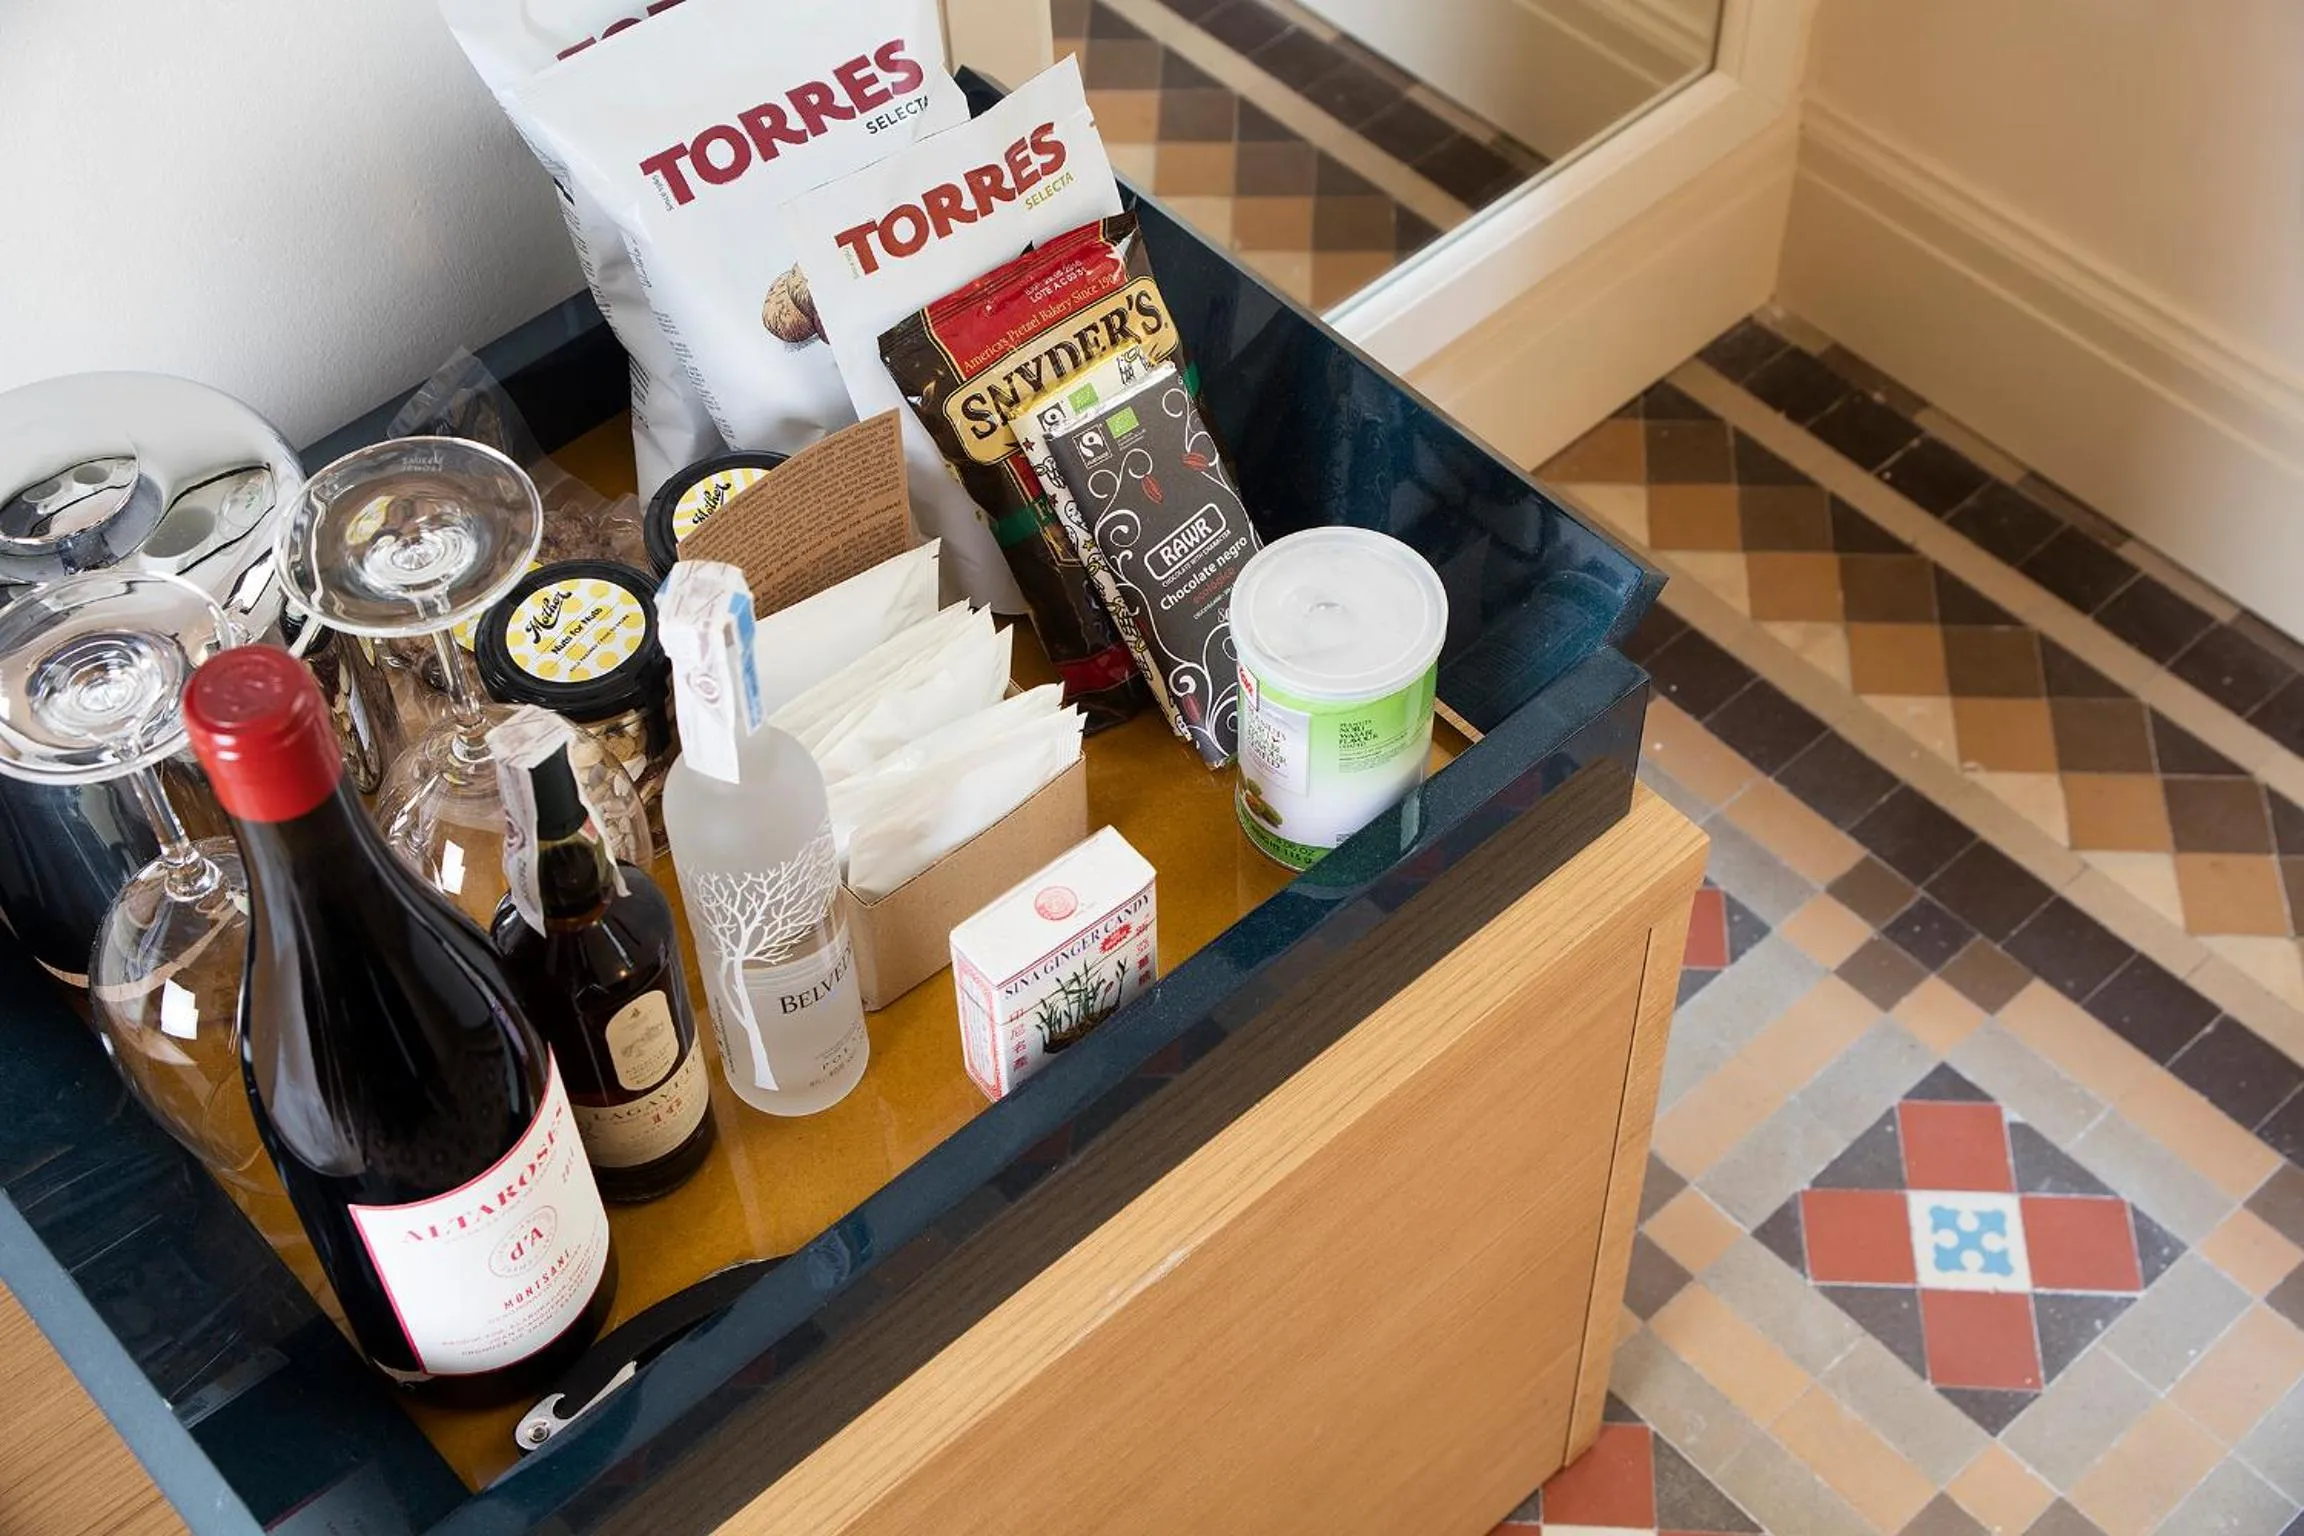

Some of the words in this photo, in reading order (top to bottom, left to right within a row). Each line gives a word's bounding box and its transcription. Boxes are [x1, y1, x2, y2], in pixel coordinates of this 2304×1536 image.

[639, 38, 923, 206] TORRES
[834, 122, 1067, 276] TORRES
[1025, 172, 1074, 210] SELECTA
[964, 335, 1012, 373] America's
[1007, 315, 1039, 345] Pretzel
[1040, 299, 1073, 324] Bakery
[1072, 284, 1099, 304] Since
[961, 290, 1164, 440] SNYDER'S
[1160, 517, 1213, 567] RAWR
[1160, 562, 1217, 611] Chocolate
[1216, 536, 1248, 567] negro
[1162, 563, 1191, 588] CHOCOLATE
[526, 591, 572, 645] Mother
[551, 632, 572, 655] Nuts
[570, 621, 585, 639] for
[583, 607, 603, 628] Nuts
[1004, 970, 1040, 999] SINA
[1044, 928, 1100, 976] GINGER
[1104, 894, 1150, 935] CANDY
[509, 1226, 544, 1262] d'A
[502, 1249, 572, 1311] MONTSANT
